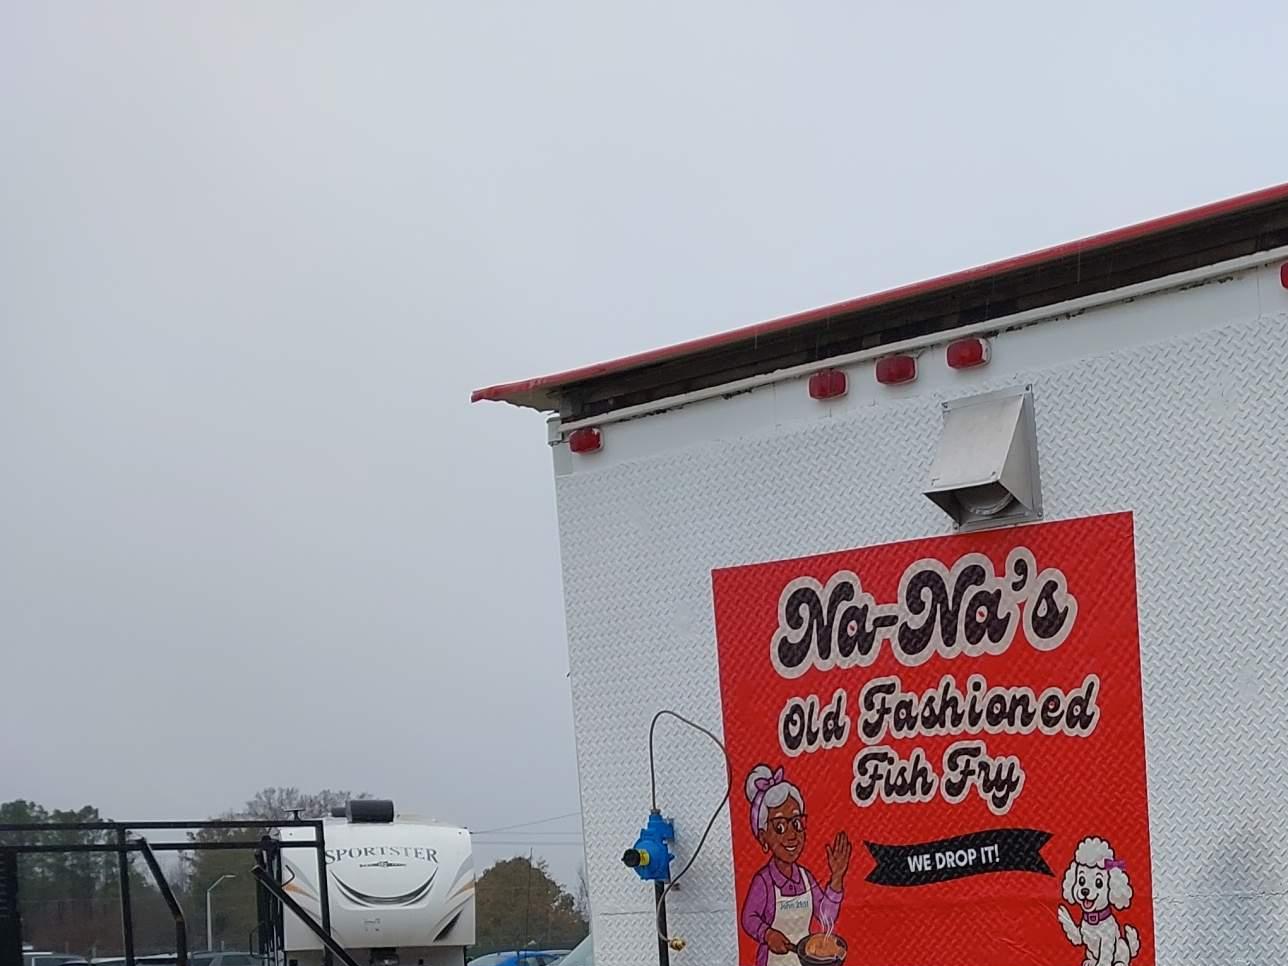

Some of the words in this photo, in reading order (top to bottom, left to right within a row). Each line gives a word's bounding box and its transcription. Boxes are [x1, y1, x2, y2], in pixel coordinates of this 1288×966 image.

[774, 550, 1073, 674] Na-Na's
[781, 690, 847, 754] Old
[858, 676, 1099, 741] Fashioned
[852, 748, 936, 803] Fish
[942, 742, 1023, 812] Fry
[325, 846, 438, 864] SPORTSTER
[907, 854, 932, 872] WE
[935, 849, 977, 869] DROP
[980, 843, 1000, 865] IT!
